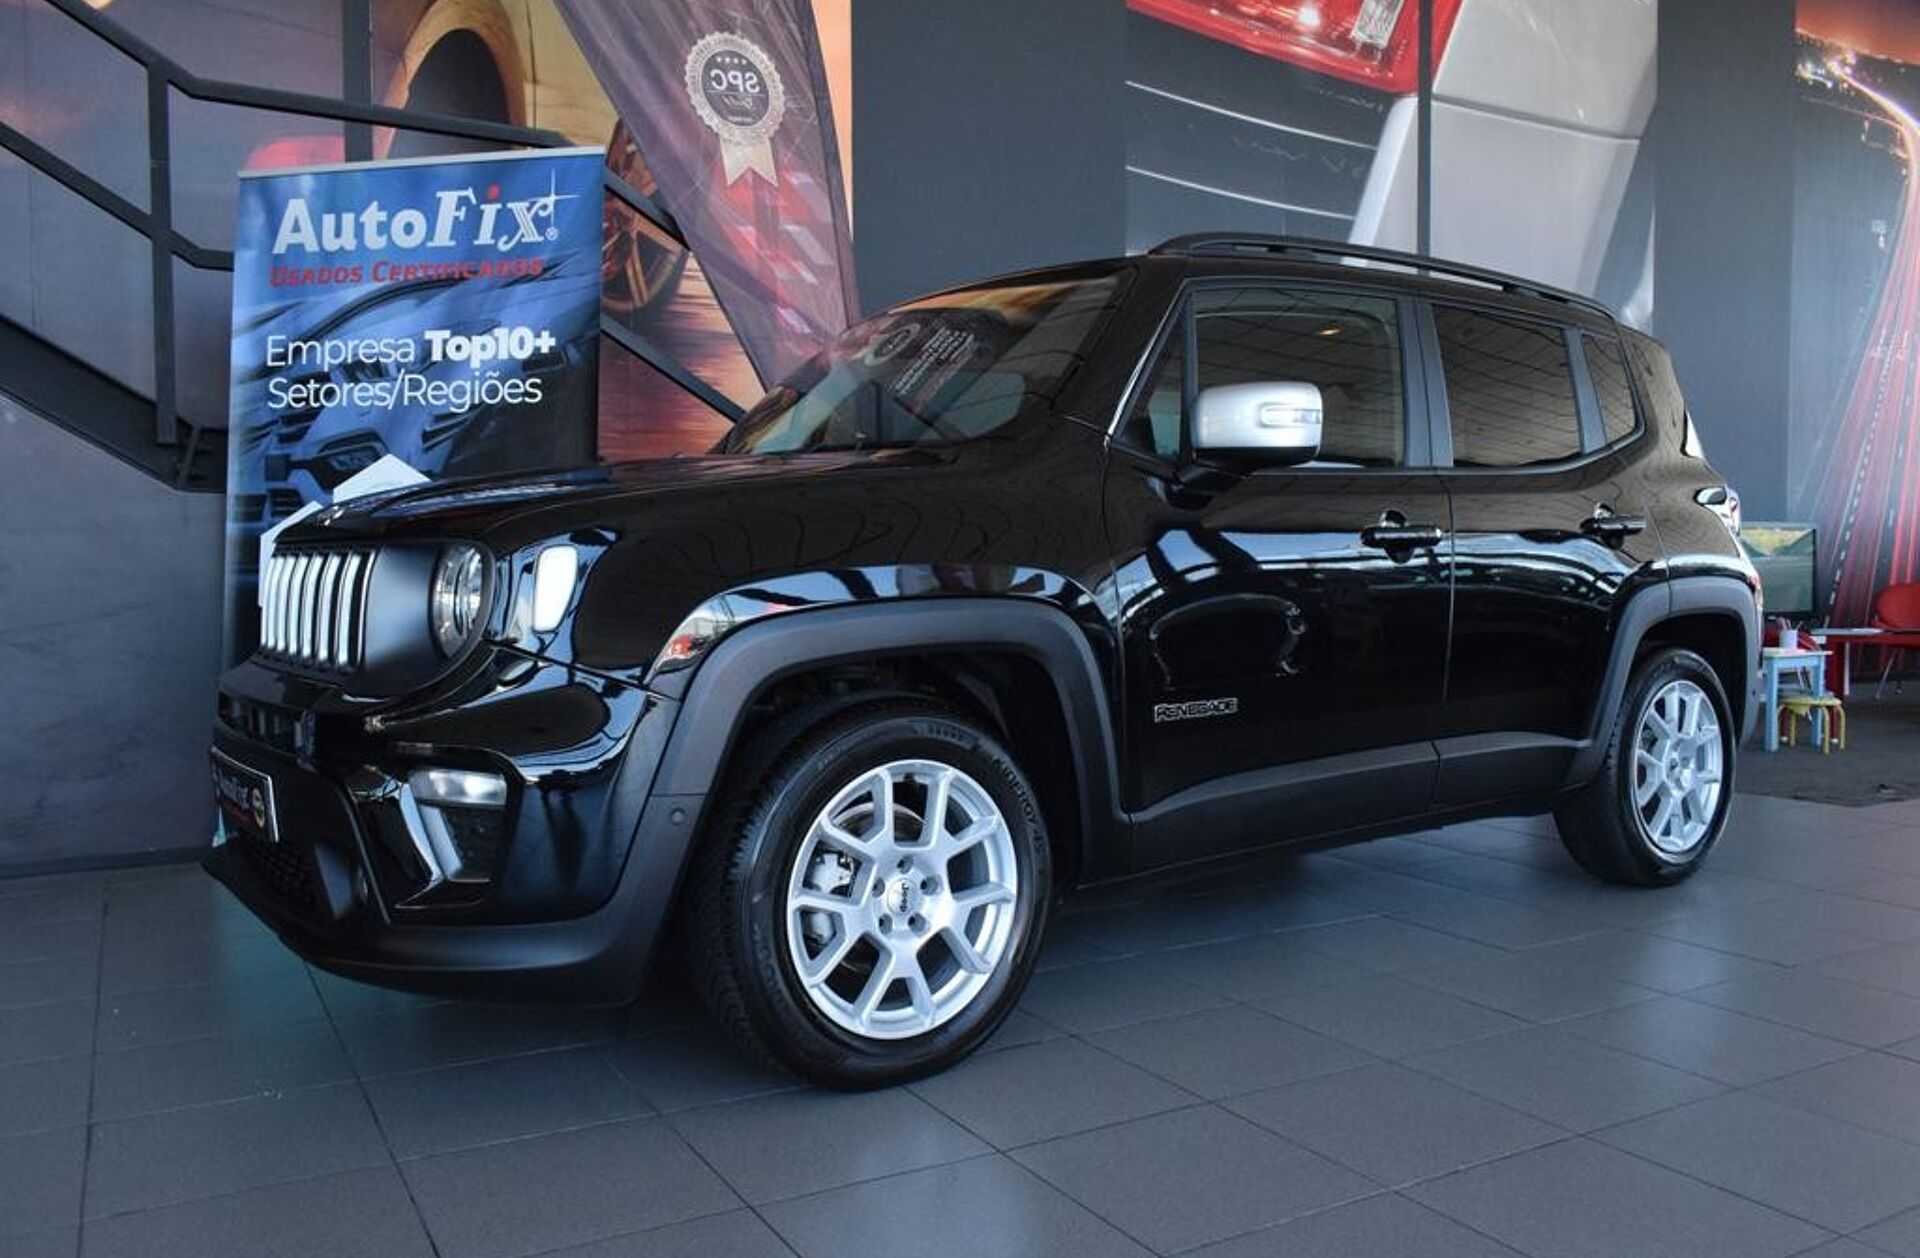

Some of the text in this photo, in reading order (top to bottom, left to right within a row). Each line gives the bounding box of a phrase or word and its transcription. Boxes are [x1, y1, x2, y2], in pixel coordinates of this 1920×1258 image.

[269, 260, 545, 287] USADOS CERTIFICADOS
[266, 327, 556, 371] Empresa Top10+
[267, 370, 543, 413] Setores/Regiões
[1154, 698, 1238, 723] RENEGADE
